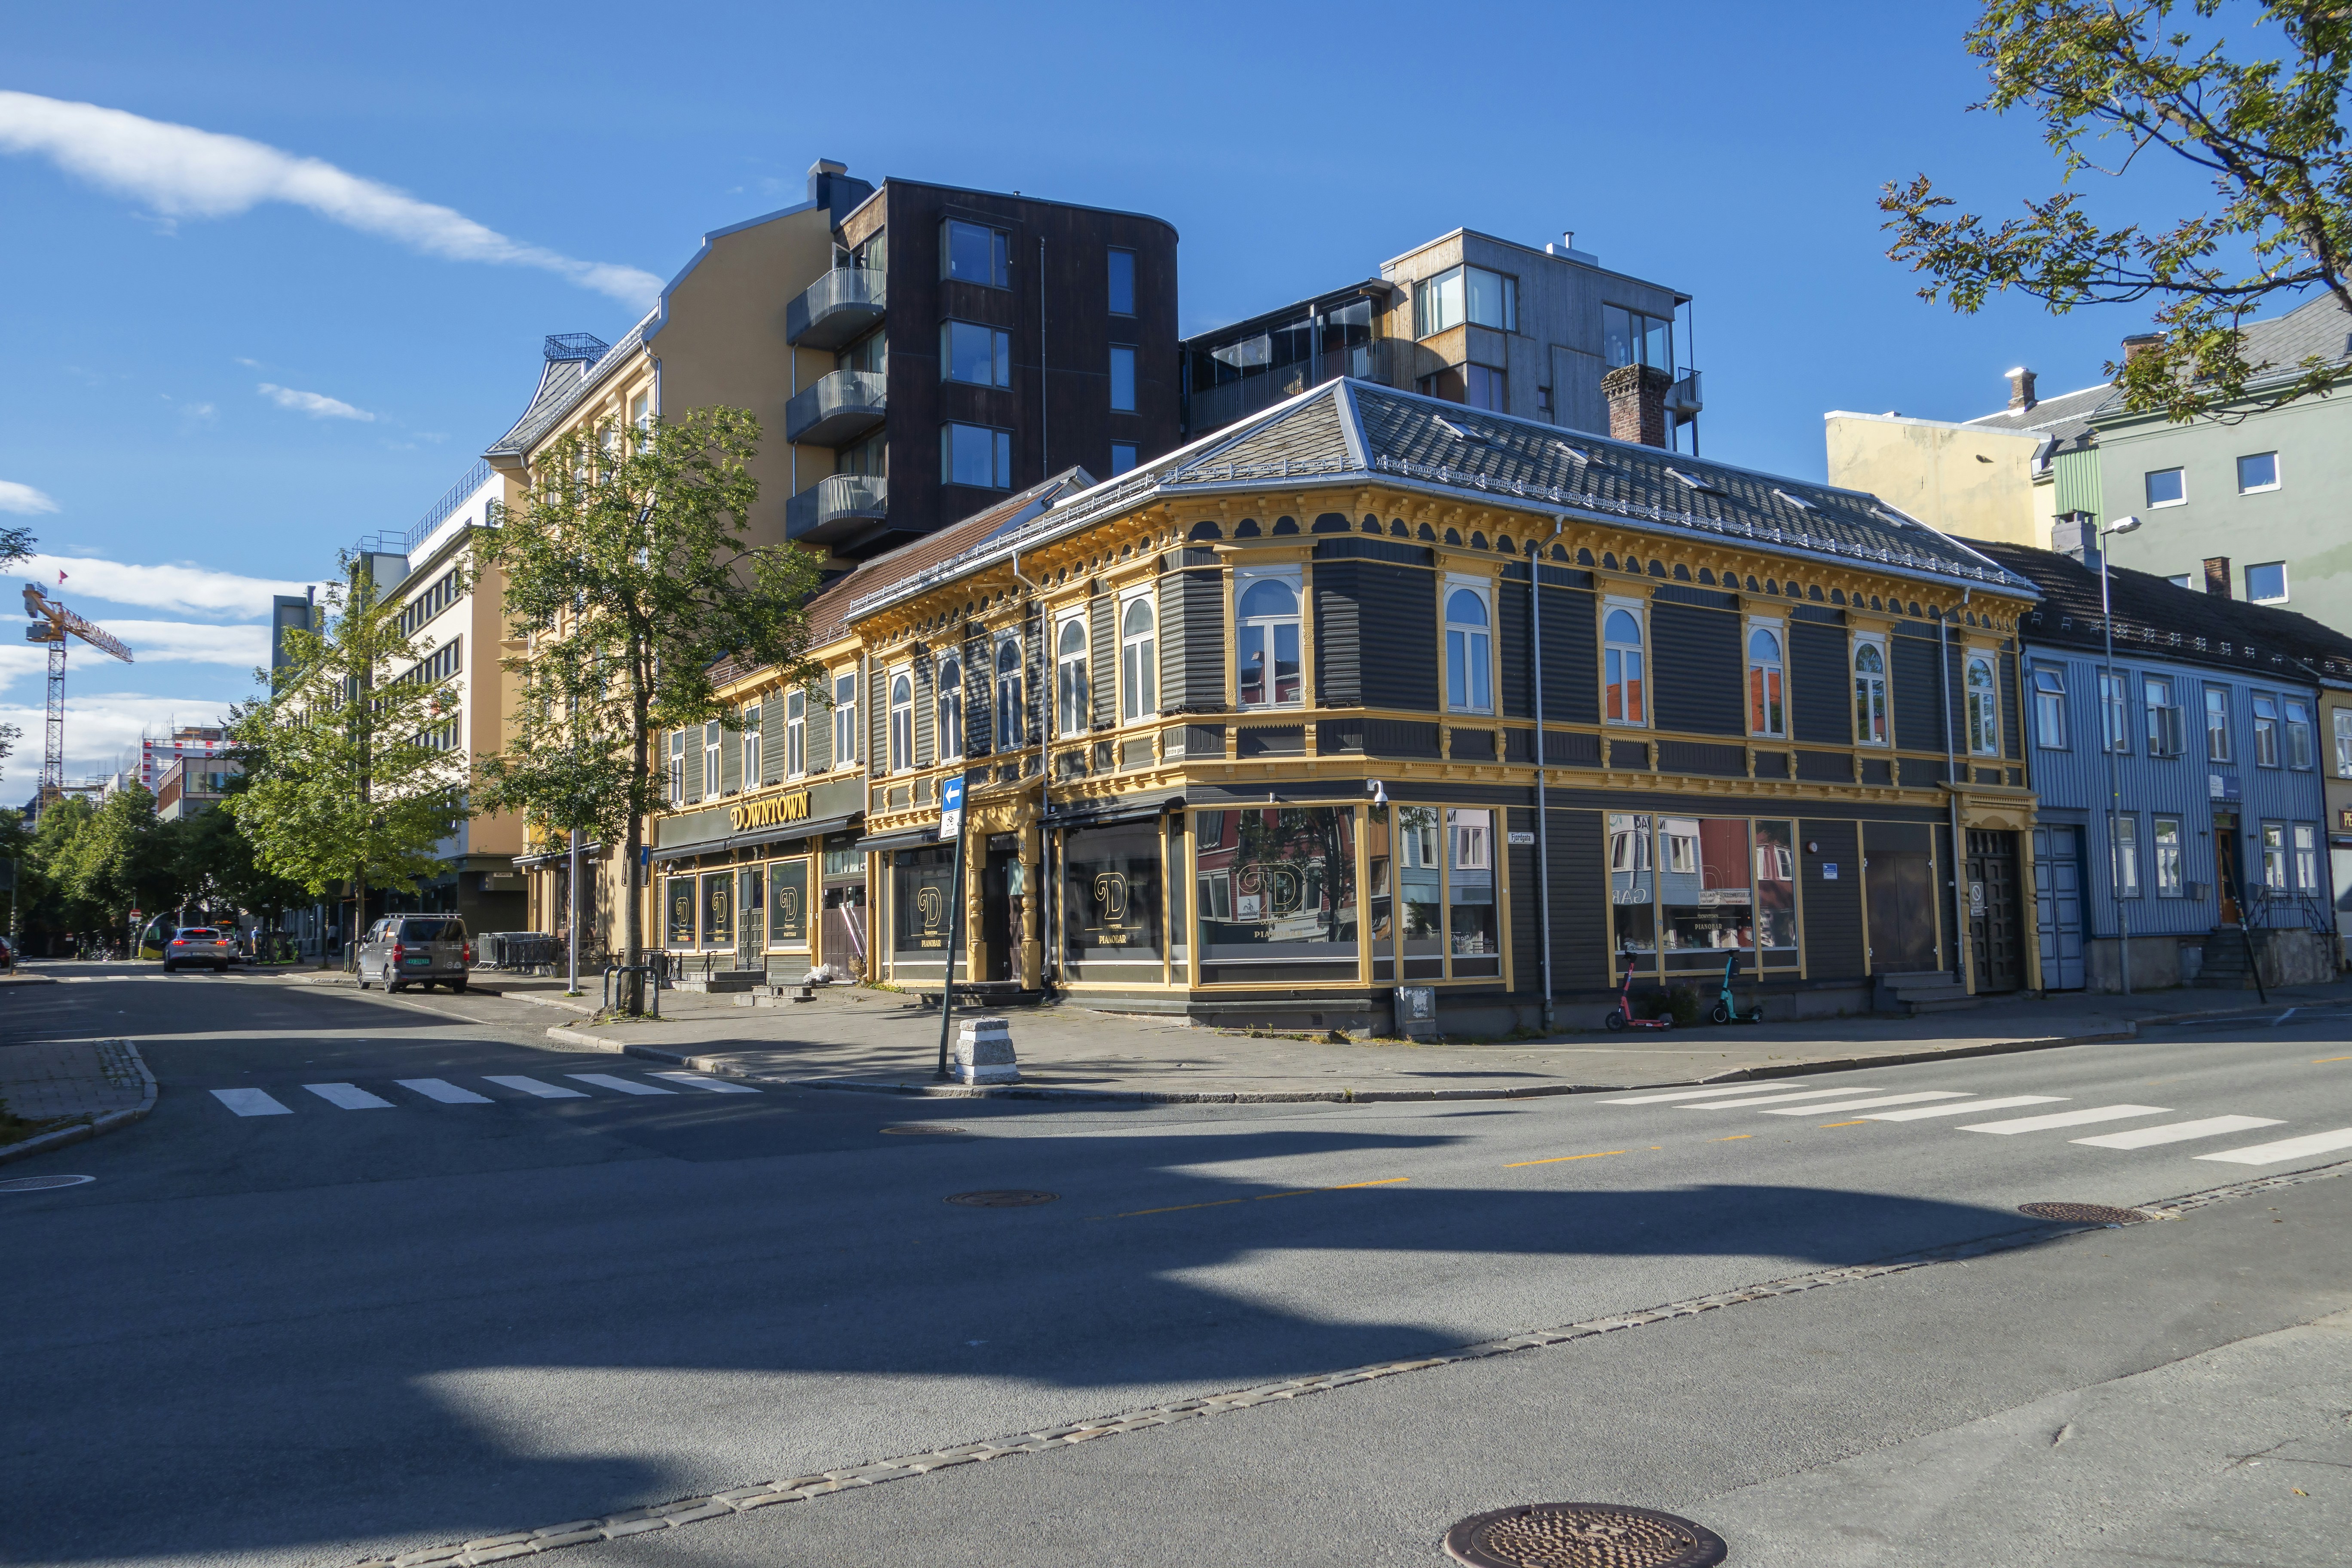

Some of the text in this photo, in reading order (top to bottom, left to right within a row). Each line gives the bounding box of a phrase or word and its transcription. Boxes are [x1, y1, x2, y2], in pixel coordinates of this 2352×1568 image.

[730, 791, 808, 830] DOWNTOWN
[1511, 833, 1531, 842] Fjordgata
[1254, 930, 1303, 938] PIANOBAR
[1099, 934, 1127, 944] PIANOBAR
